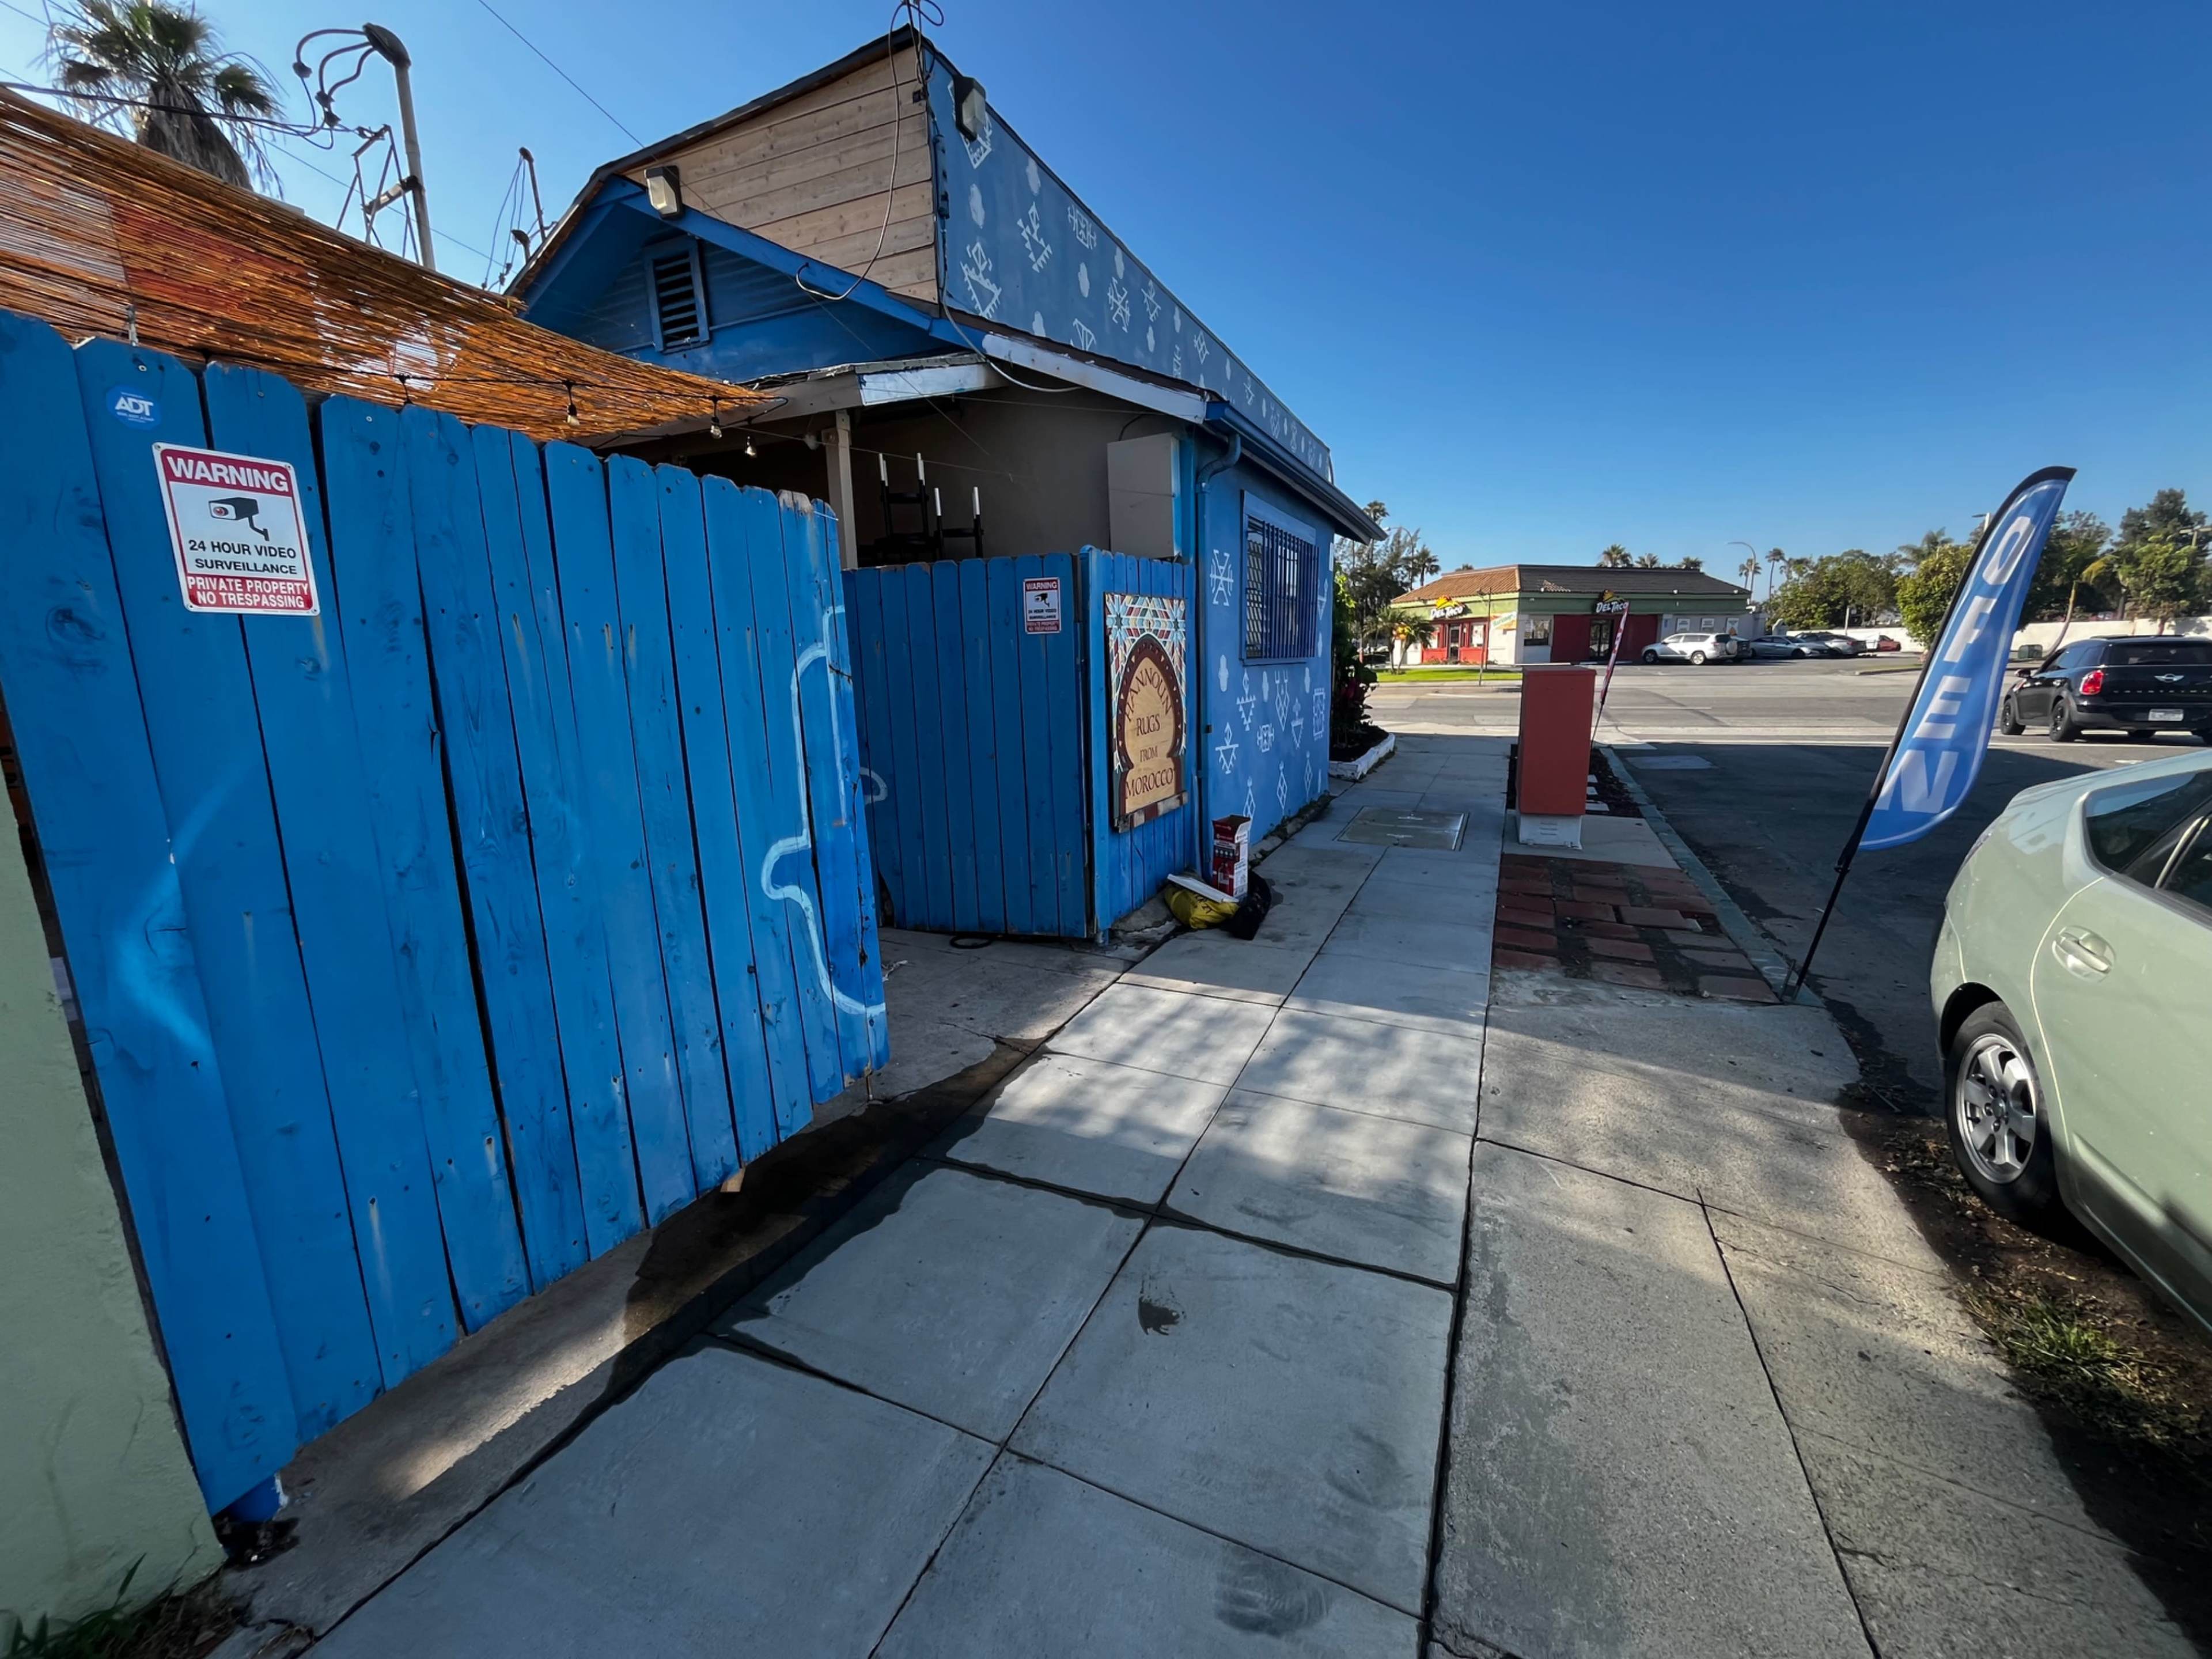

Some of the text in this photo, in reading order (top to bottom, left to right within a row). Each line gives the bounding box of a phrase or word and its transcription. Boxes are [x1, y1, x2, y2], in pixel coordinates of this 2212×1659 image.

[115, 396, 154, 416] ADT
[167, 456, 289, 492] WARNING
[188, 539, 296, 559] 24 HOUR VIDEO
[195, 559, 297, 574] SURVEILLANCE
[187, 577, 309, 595] PRIVATE PROPERTY
[1026, 581, 1057, 590] WARNING
[196, 591, 305, 608] NO TRESPASSING
[1596, 601, 1628, 613] DEL TACO
[1430, 605, 1464, 620] DEL TACO
[1125, 668, 1173, 721] HANNOUN
[1136, 714, 1161, 736] RUGS
[1139, 745, 1158, 763] FROM
[1125, 767, 1174, 799] MOROCCO
